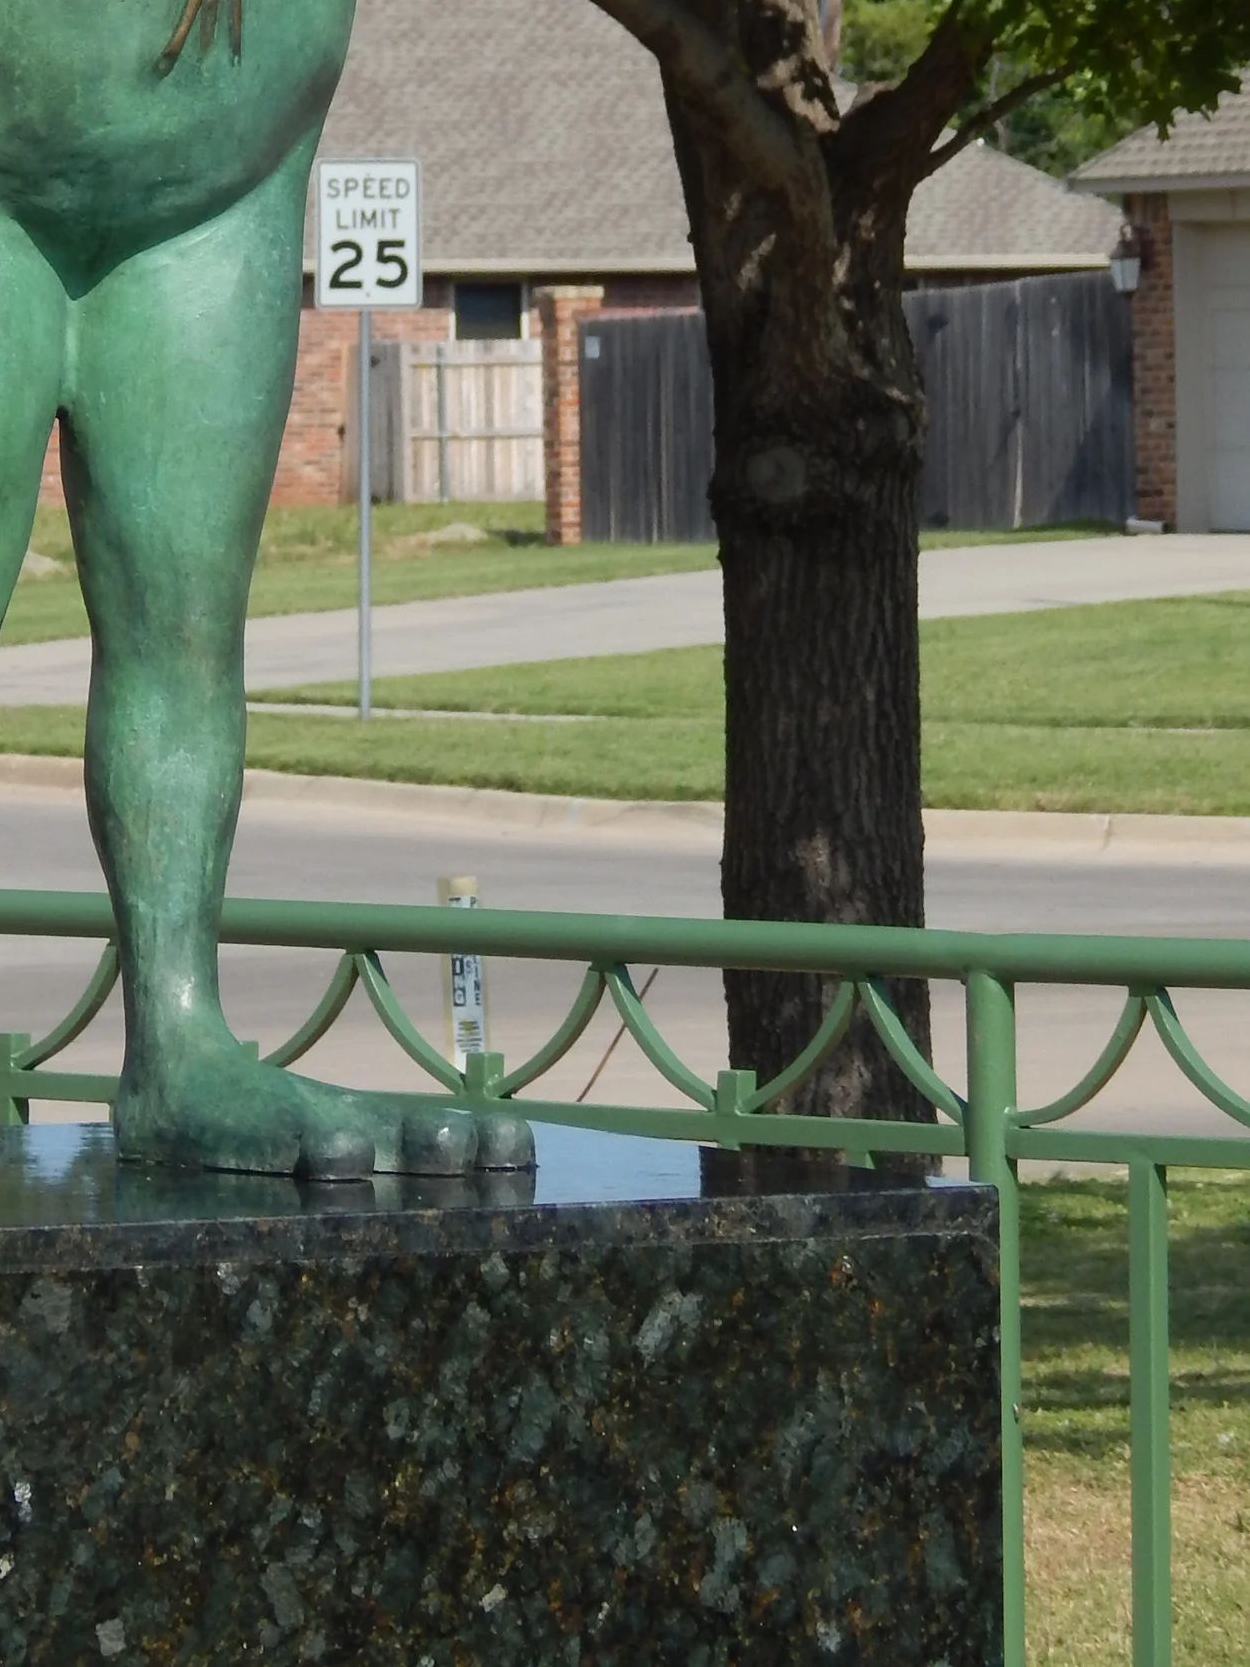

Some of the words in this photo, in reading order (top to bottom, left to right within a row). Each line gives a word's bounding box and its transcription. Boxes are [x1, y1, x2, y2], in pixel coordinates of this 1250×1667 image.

[326, 177, 411, 199] SPEED
[336, 208, 401, 230] LIMIT
[329, 238, 409, 289] 25
